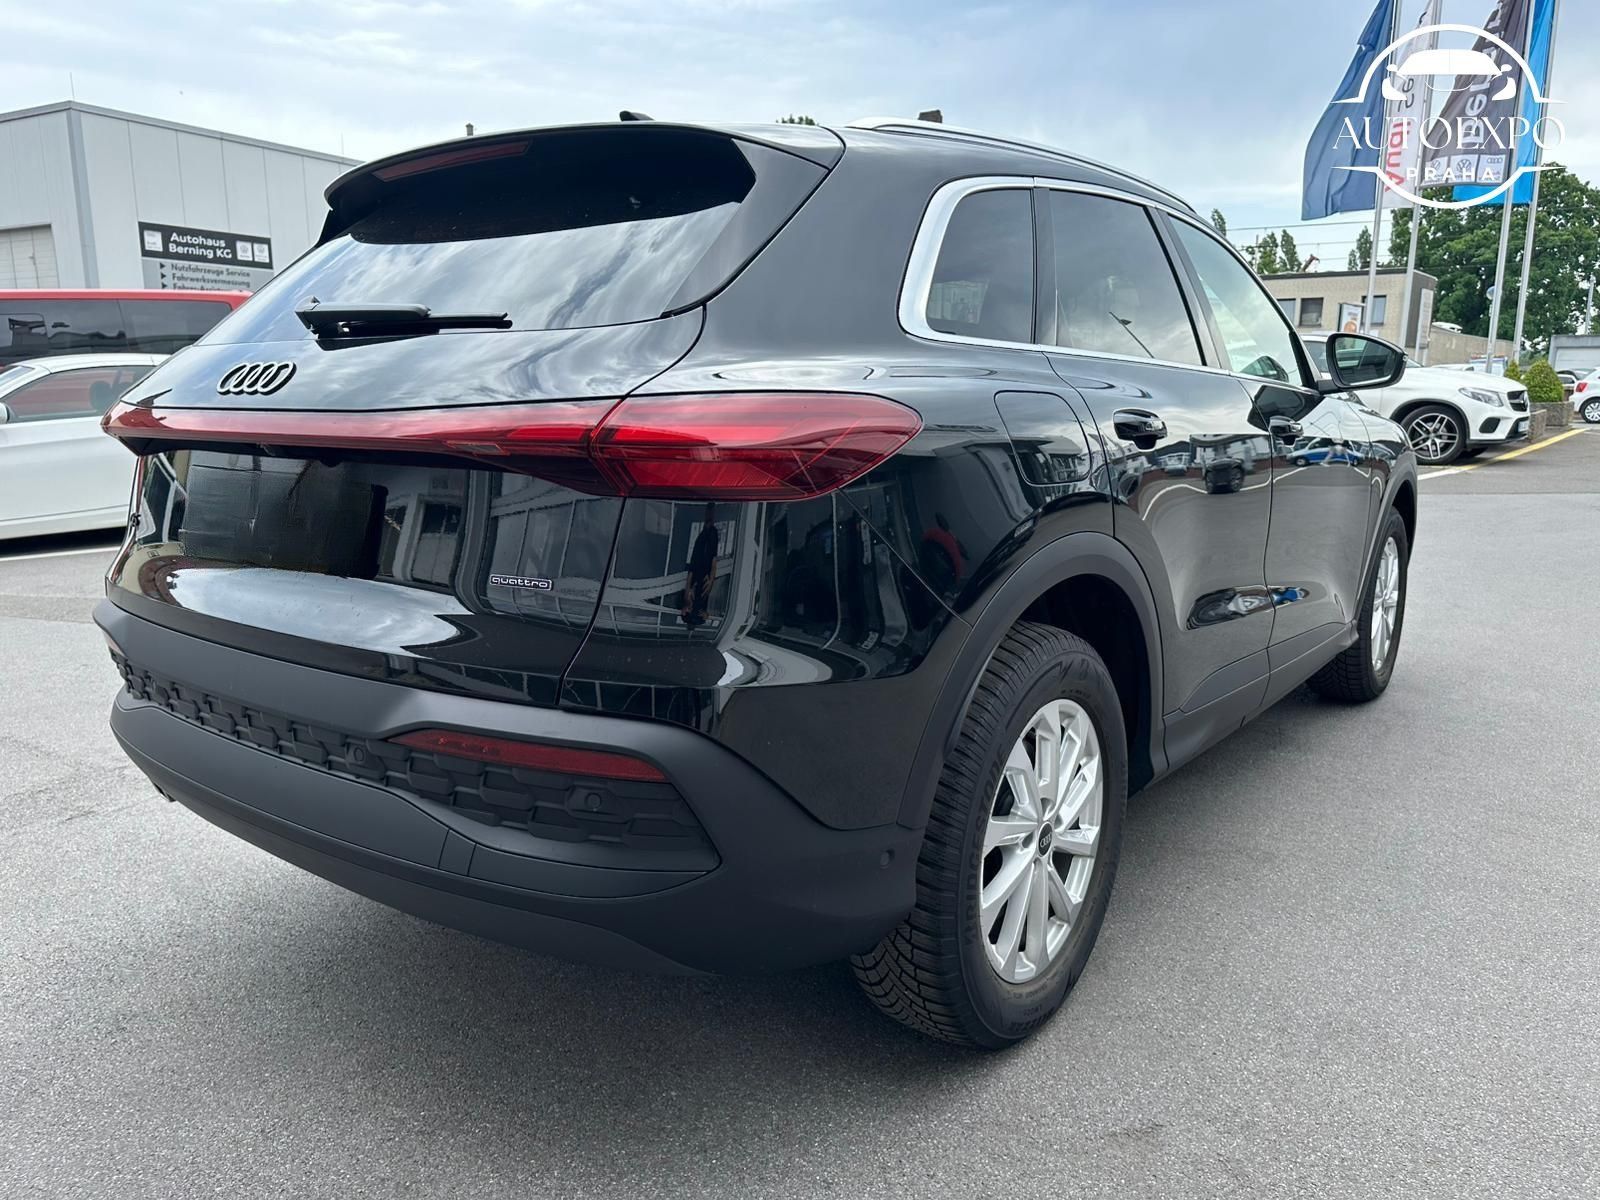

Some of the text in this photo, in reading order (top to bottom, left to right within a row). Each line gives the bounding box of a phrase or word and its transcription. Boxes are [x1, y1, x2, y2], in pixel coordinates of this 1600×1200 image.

[170, 232, 226, 247] Autohaus
[168, 243, 214, 259] Berning
[216, 248, 232, 259] KG
[171, 263, 250, 277] Nutzfahrzeuge Service
[172, 272, 250, 289] Fahrwerksvermessung
[491, 577, 548, 588] quattro
